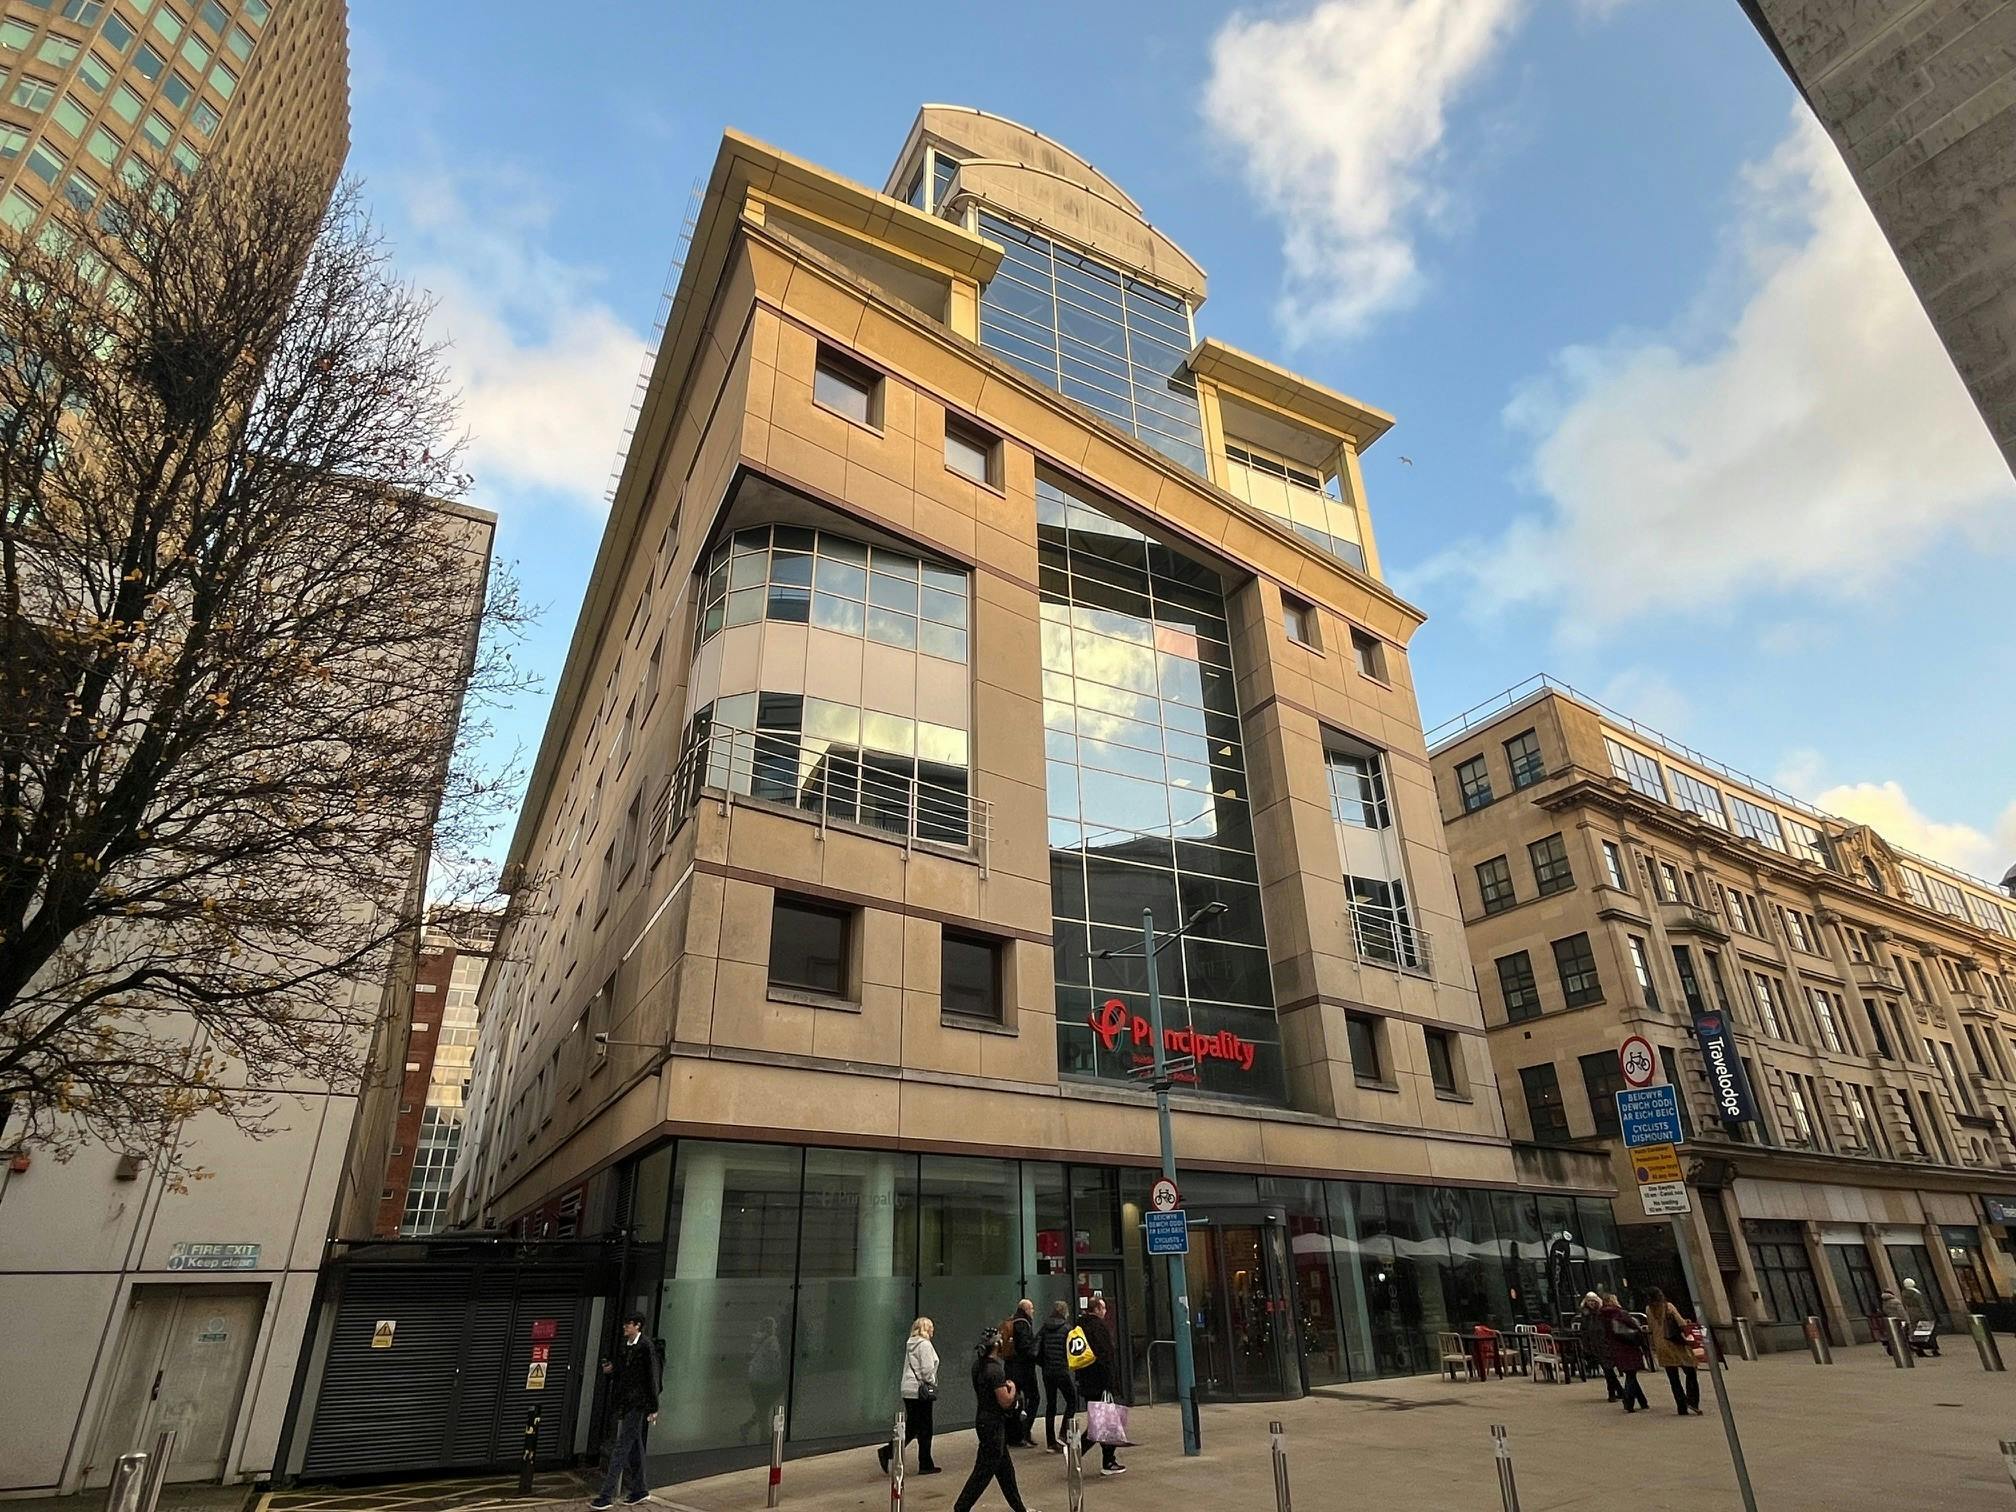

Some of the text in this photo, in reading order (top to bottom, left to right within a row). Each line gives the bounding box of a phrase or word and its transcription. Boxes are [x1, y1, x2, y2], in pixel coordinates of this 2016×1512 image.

[1132, 1015, 1255, 1071] Prncipality
[1708, 1036, 1740, 1116] Travelodge
[1628, 1090, 1663, 1102] BEICWYR
[1621, 1099, 1673, 1112] DEWCH ODDI
[1623, 1107, 1675, 1121] AR EICH BEIC
[1632, 1121, 1669, 1133] CYCLISTS
[1631, 1131, 1673, 1143] DISMOUNT
[191, 1245, 223, 1255] FIRE
[187, 1258, 255, 1268] Keep clear
[1070, 1337, 1085, 1354] JD
